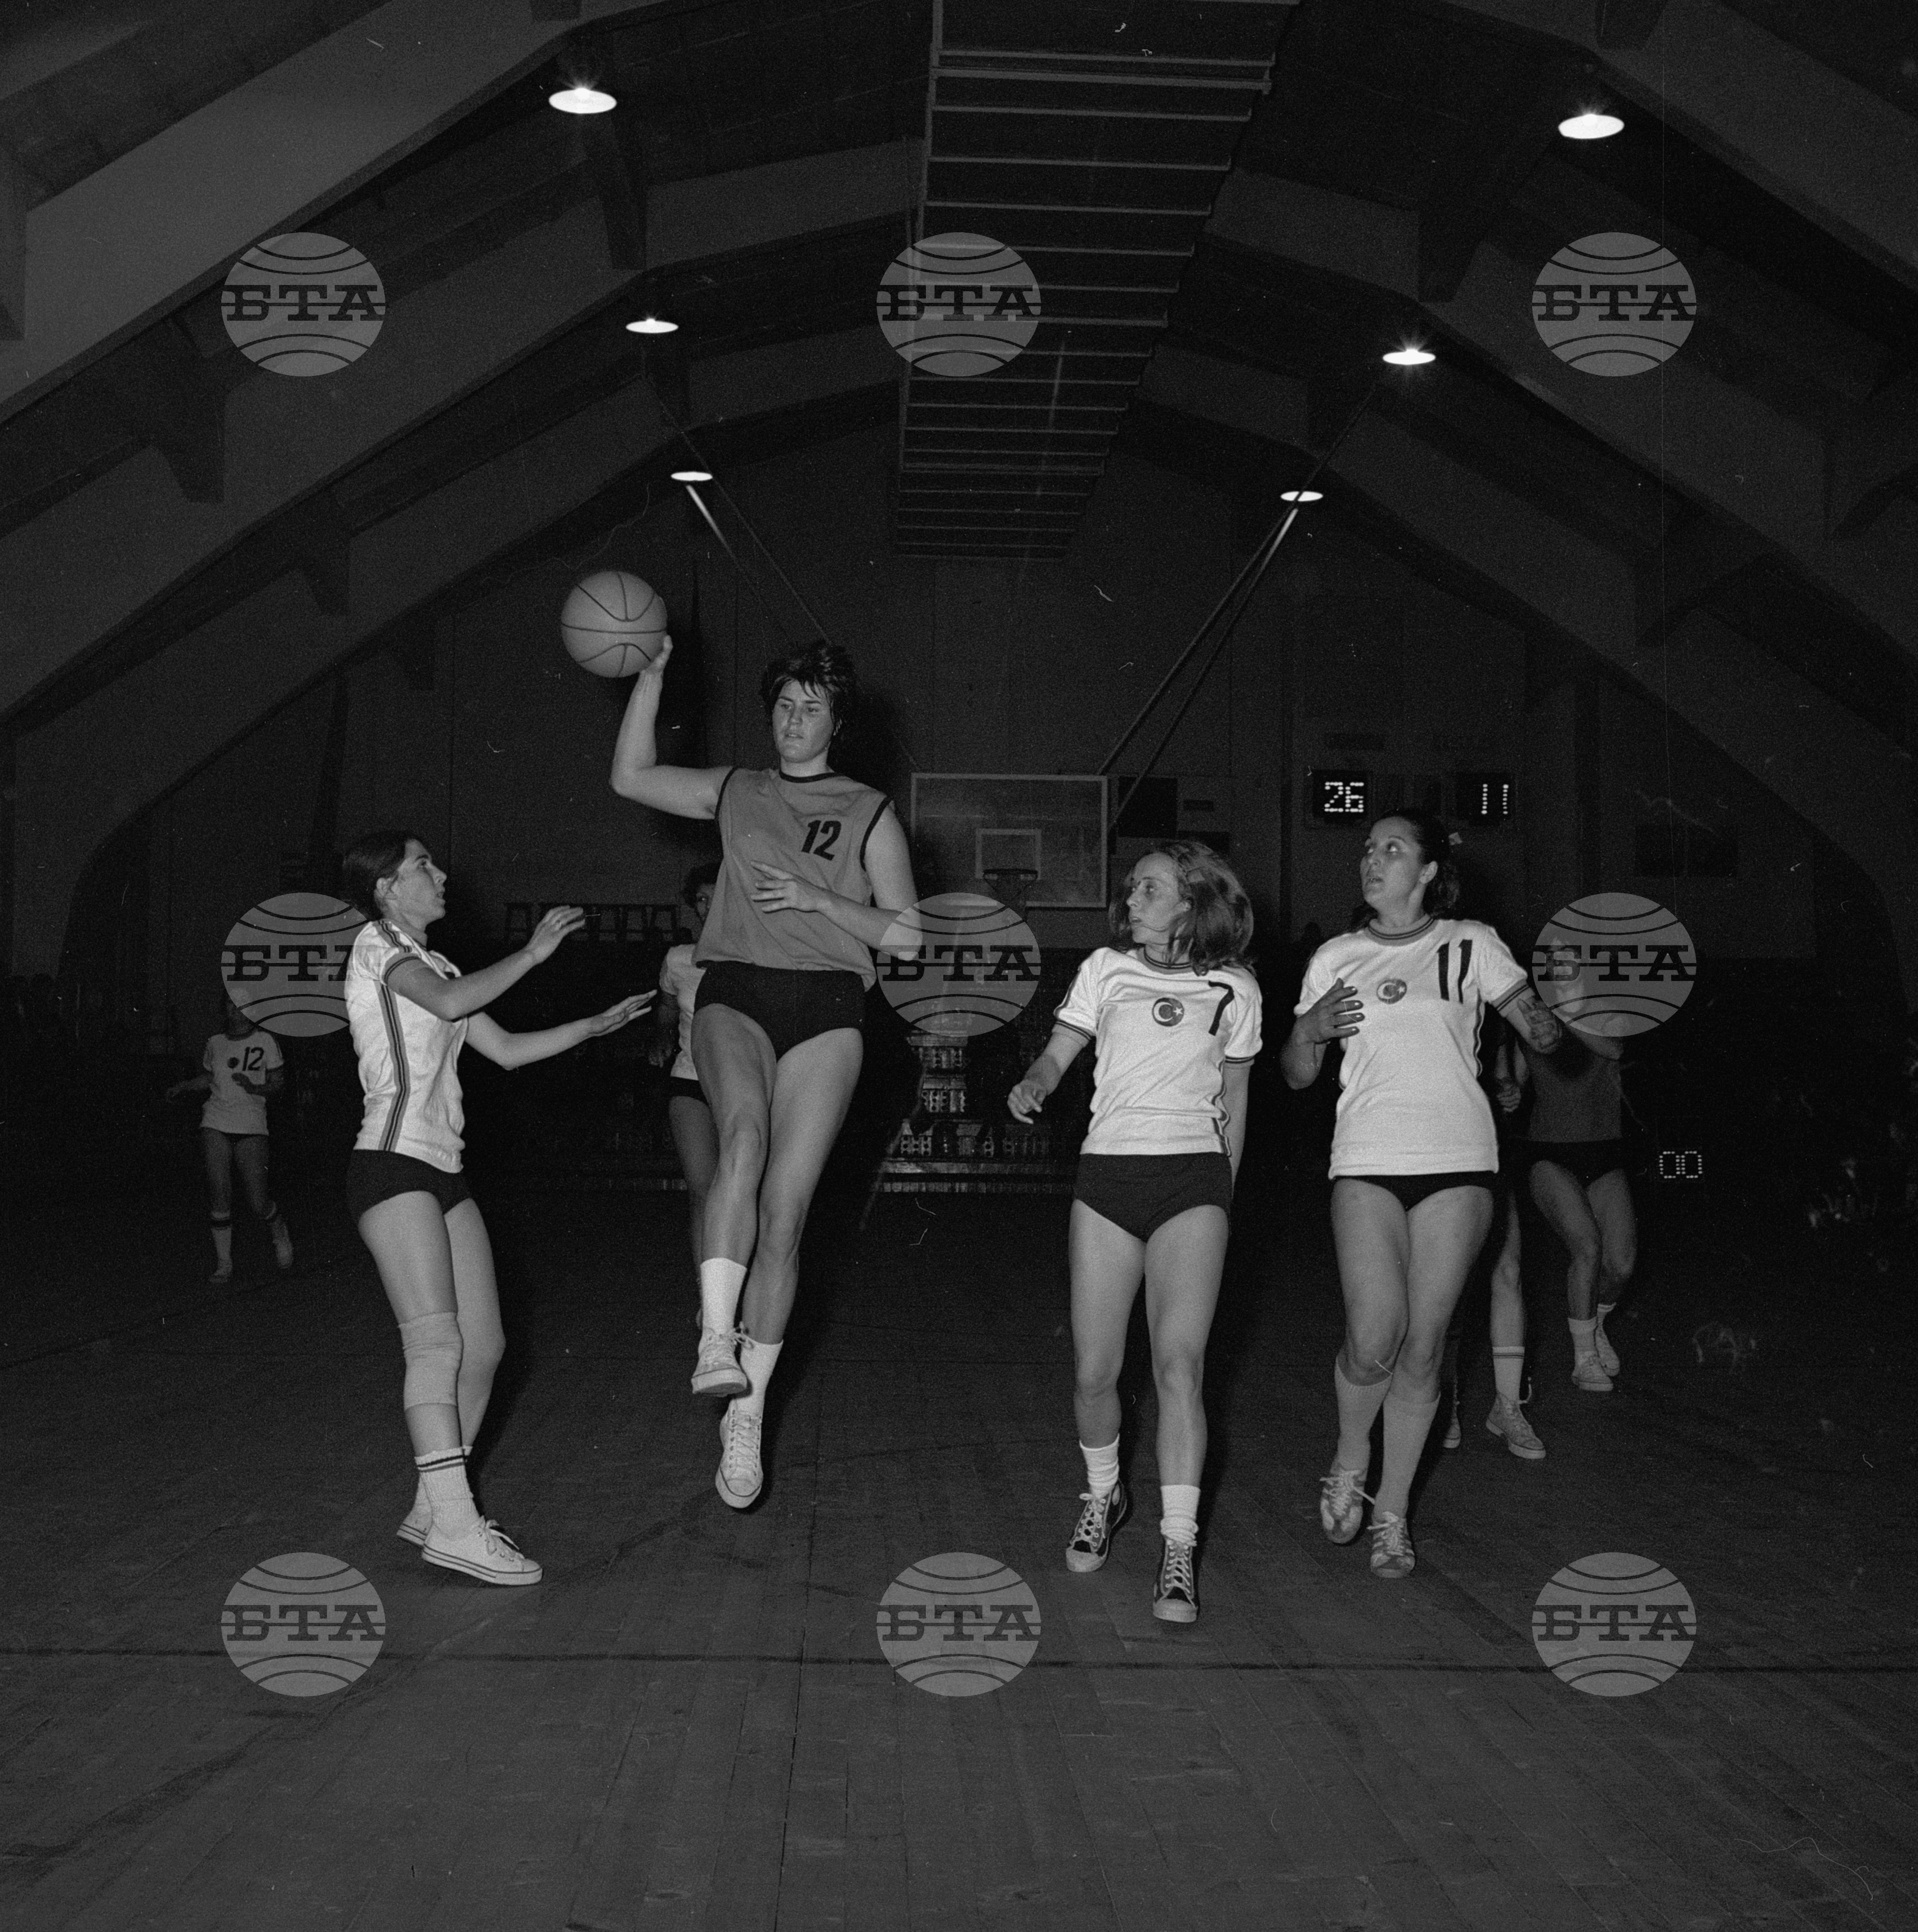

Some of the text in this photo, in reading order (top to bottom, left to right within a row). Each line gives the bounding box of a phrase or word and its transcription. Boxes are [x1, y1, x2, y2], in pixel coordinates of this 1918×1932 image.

[1324, 782, 1364, 812] 26
[1481, 783, 1509, 814] 11
[801, 820, 841, 861] 12
[1436, 939, 1473, 1005] 11
[1208, 980, 1235, 1036] 7
[242, 1047, 264, 1071] 12
[1659, 1151, 1703, 1179] 00
